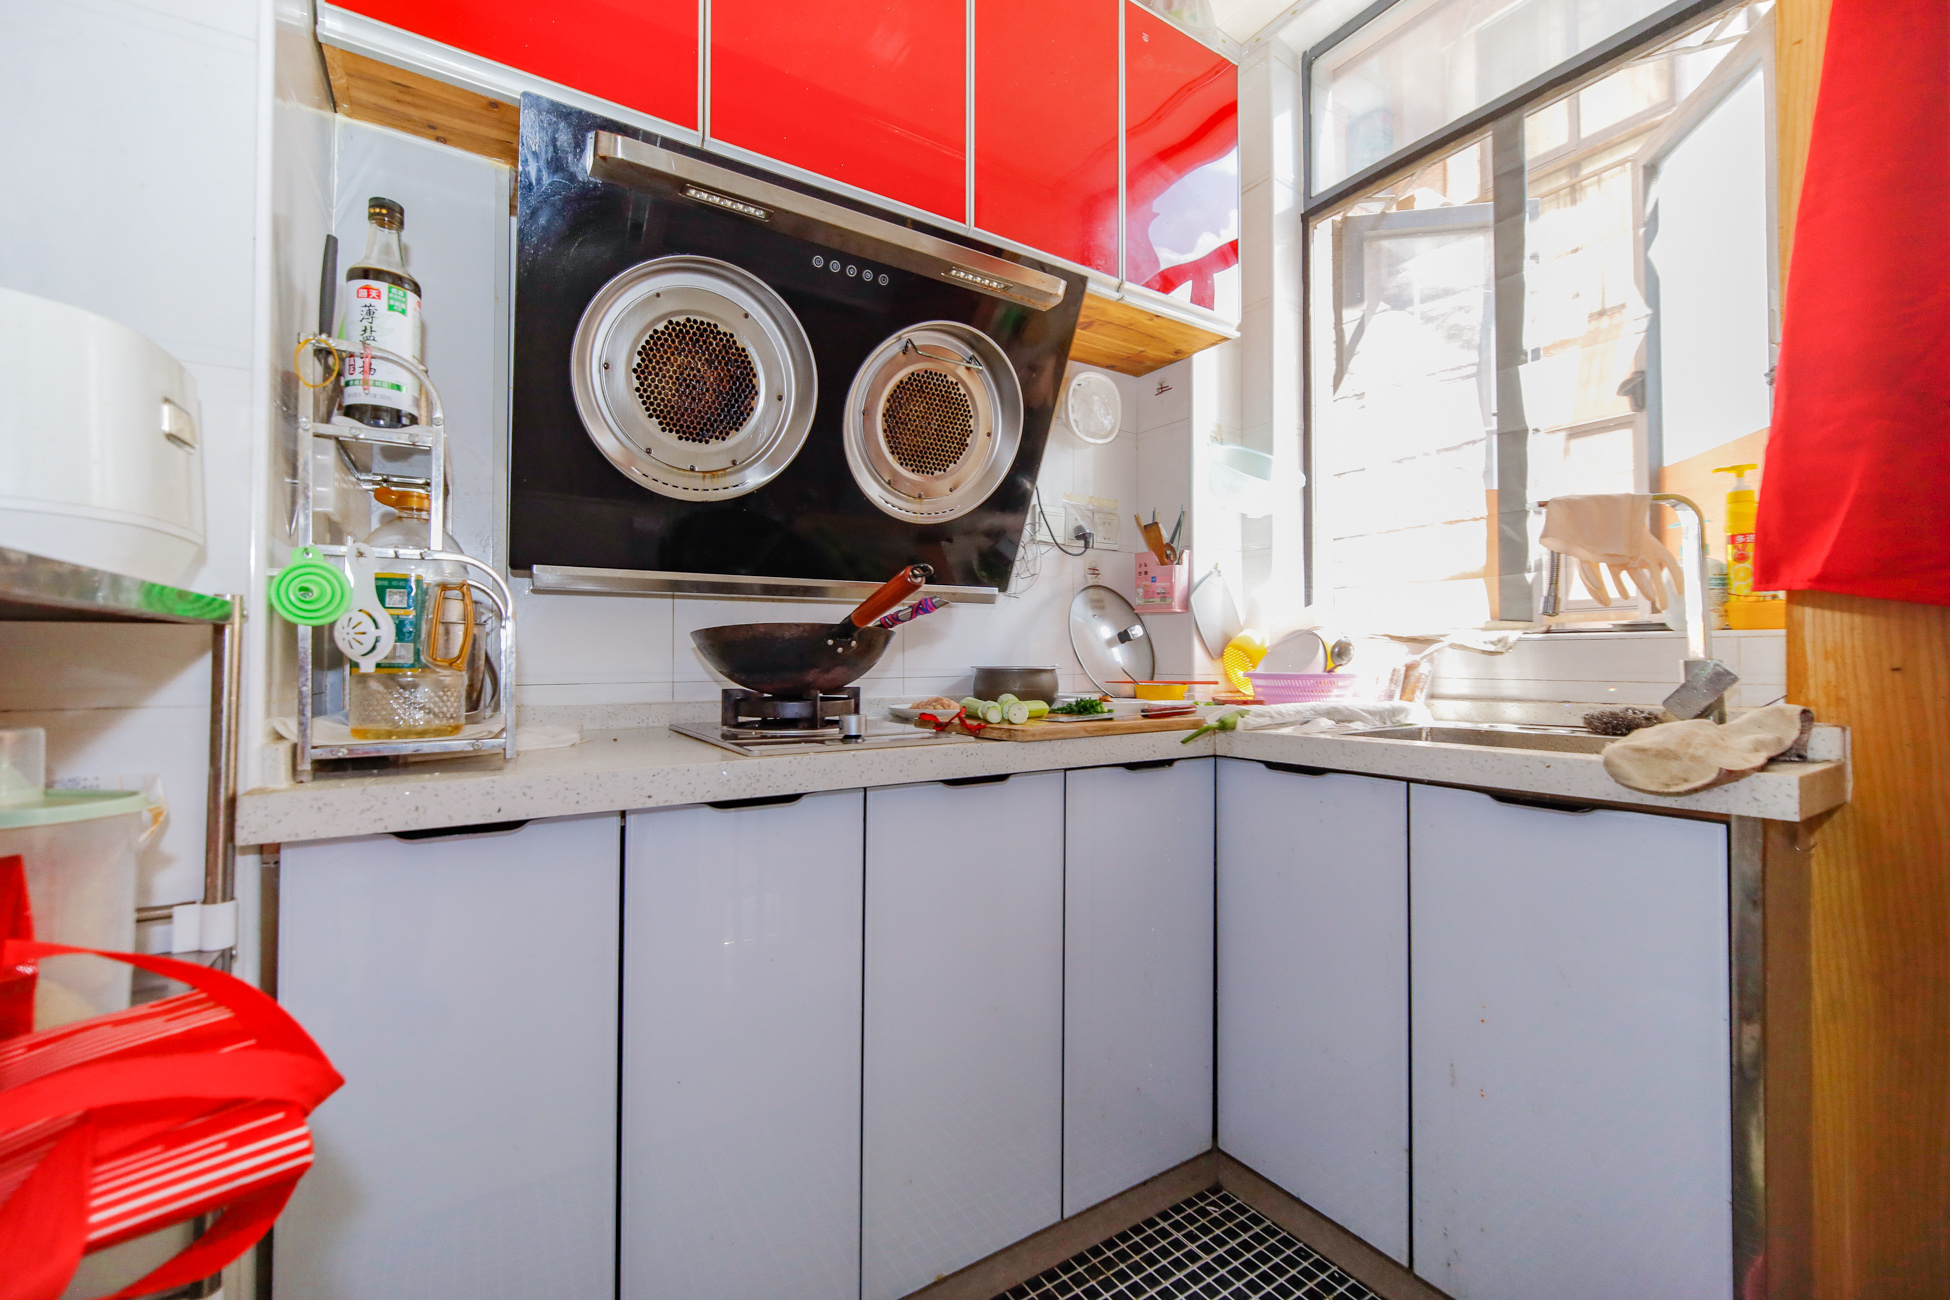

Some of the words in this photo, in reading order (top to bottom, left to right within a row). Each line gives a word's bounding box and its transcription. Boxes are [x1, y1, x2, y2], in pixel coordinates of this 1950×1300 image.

[358, 288, 379, 299] 海天
[359, 303, 377, 375] 薄盐抽
